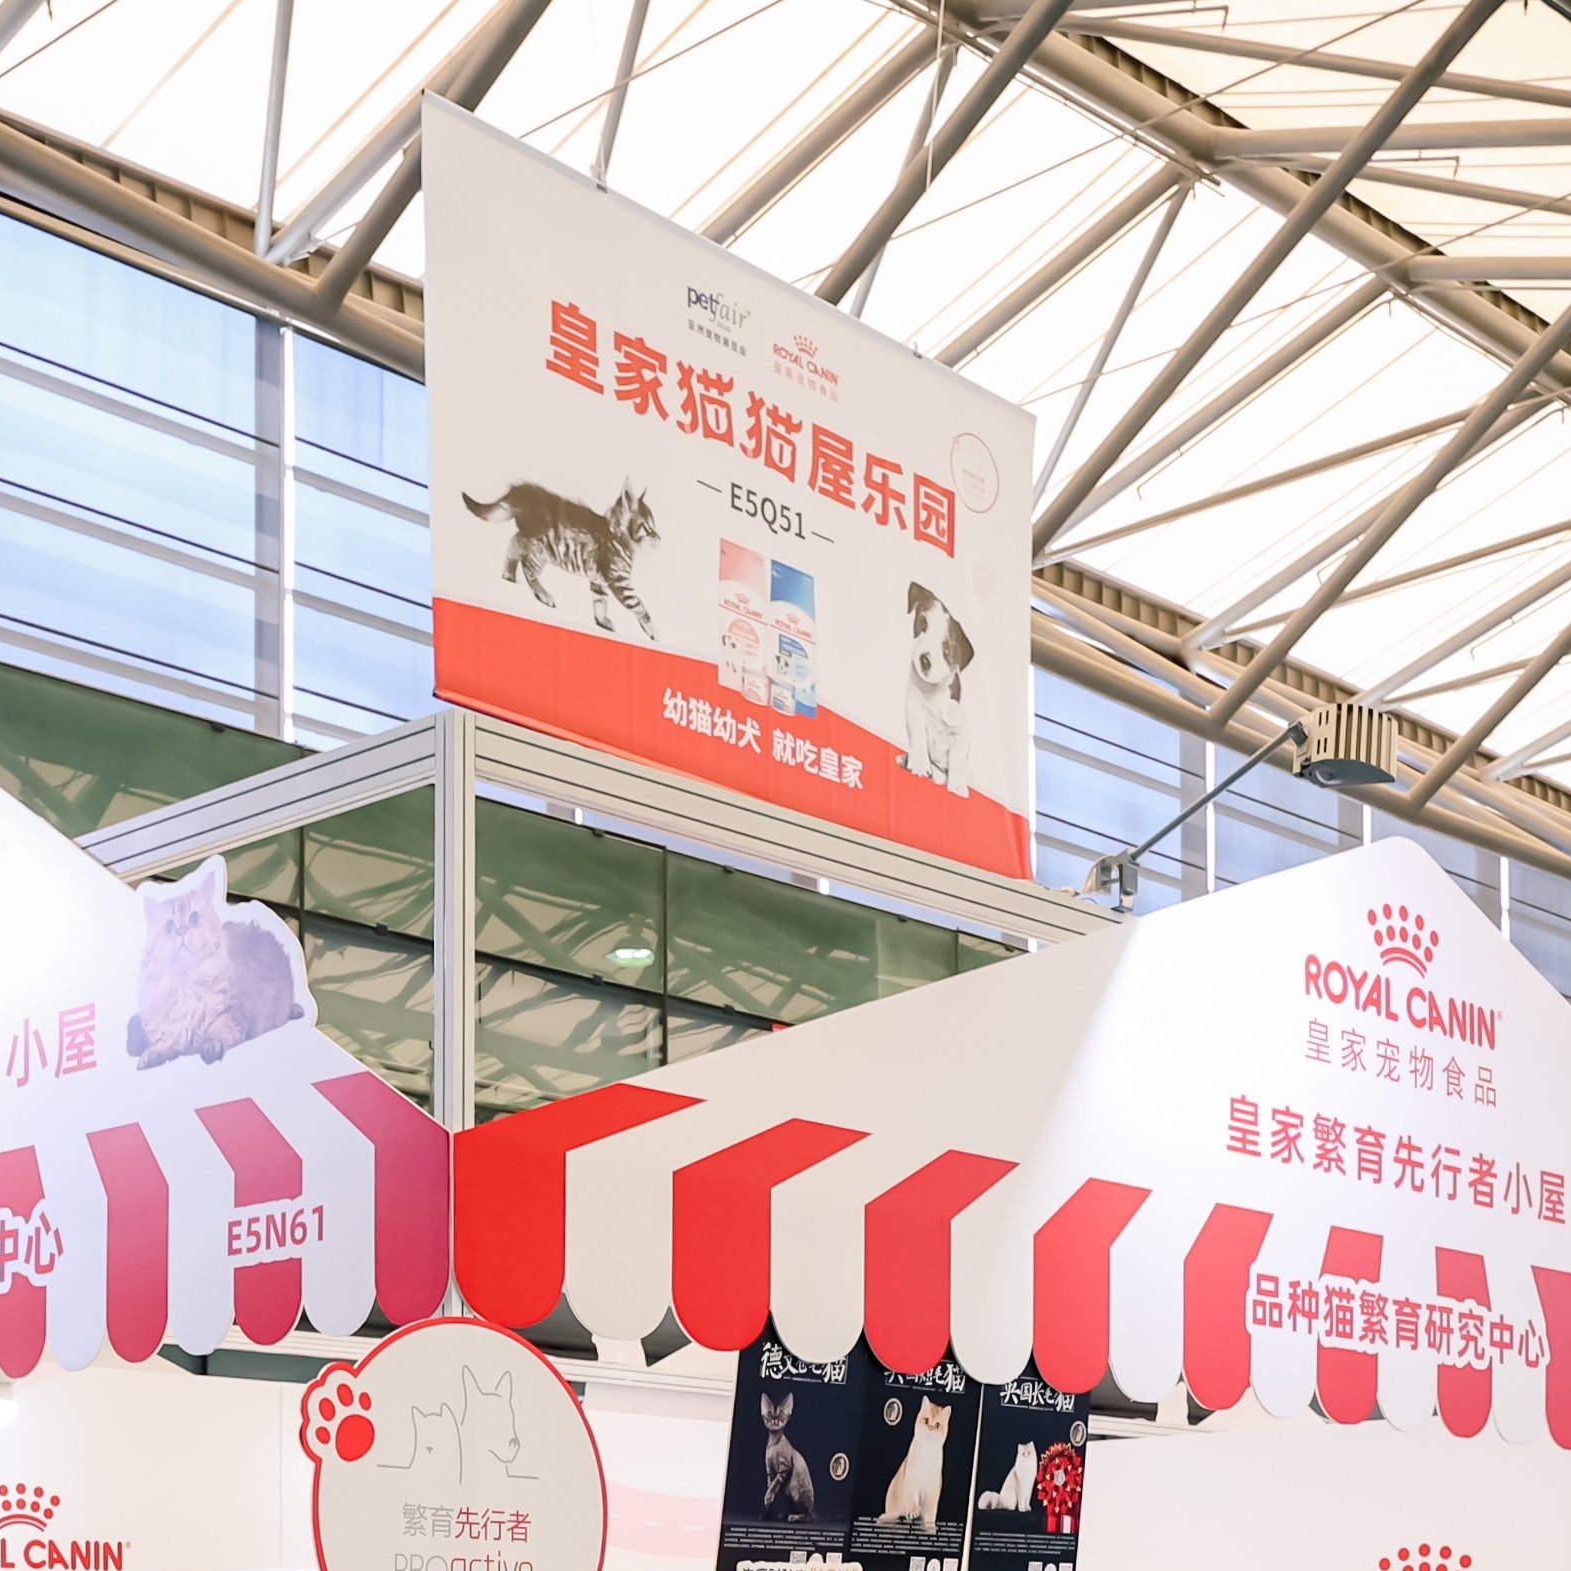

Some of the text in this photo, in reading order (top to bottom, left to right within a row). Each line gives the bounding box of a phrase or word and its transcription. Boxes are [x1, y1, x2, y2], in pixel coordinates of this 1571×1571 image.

[772, 343, 838, 386] ROYAL CANIN
[545, 299, 957, 559] 皇家猫猫屋乐园
[729, 481, 807, 541] E5Q51
[662, 687, 865, 793] 幼猫幼犬 就吃皇家
[1303, 952, 1497, 1051] ROYAL CANIN
[1303, 1016, 1499, 1109] 皇家宠物食品
[1225, 1093, 1568, 1226] 皇家繁育先行者小屋
[227, 1205, 328, 1259] E5N61
[1250, 1278, 1547, 1370] 品种猫繁育研究中心
[23, 1539, 124, 1571] CANIN
[402, 1502, 532, 1543] 繁育先行者
